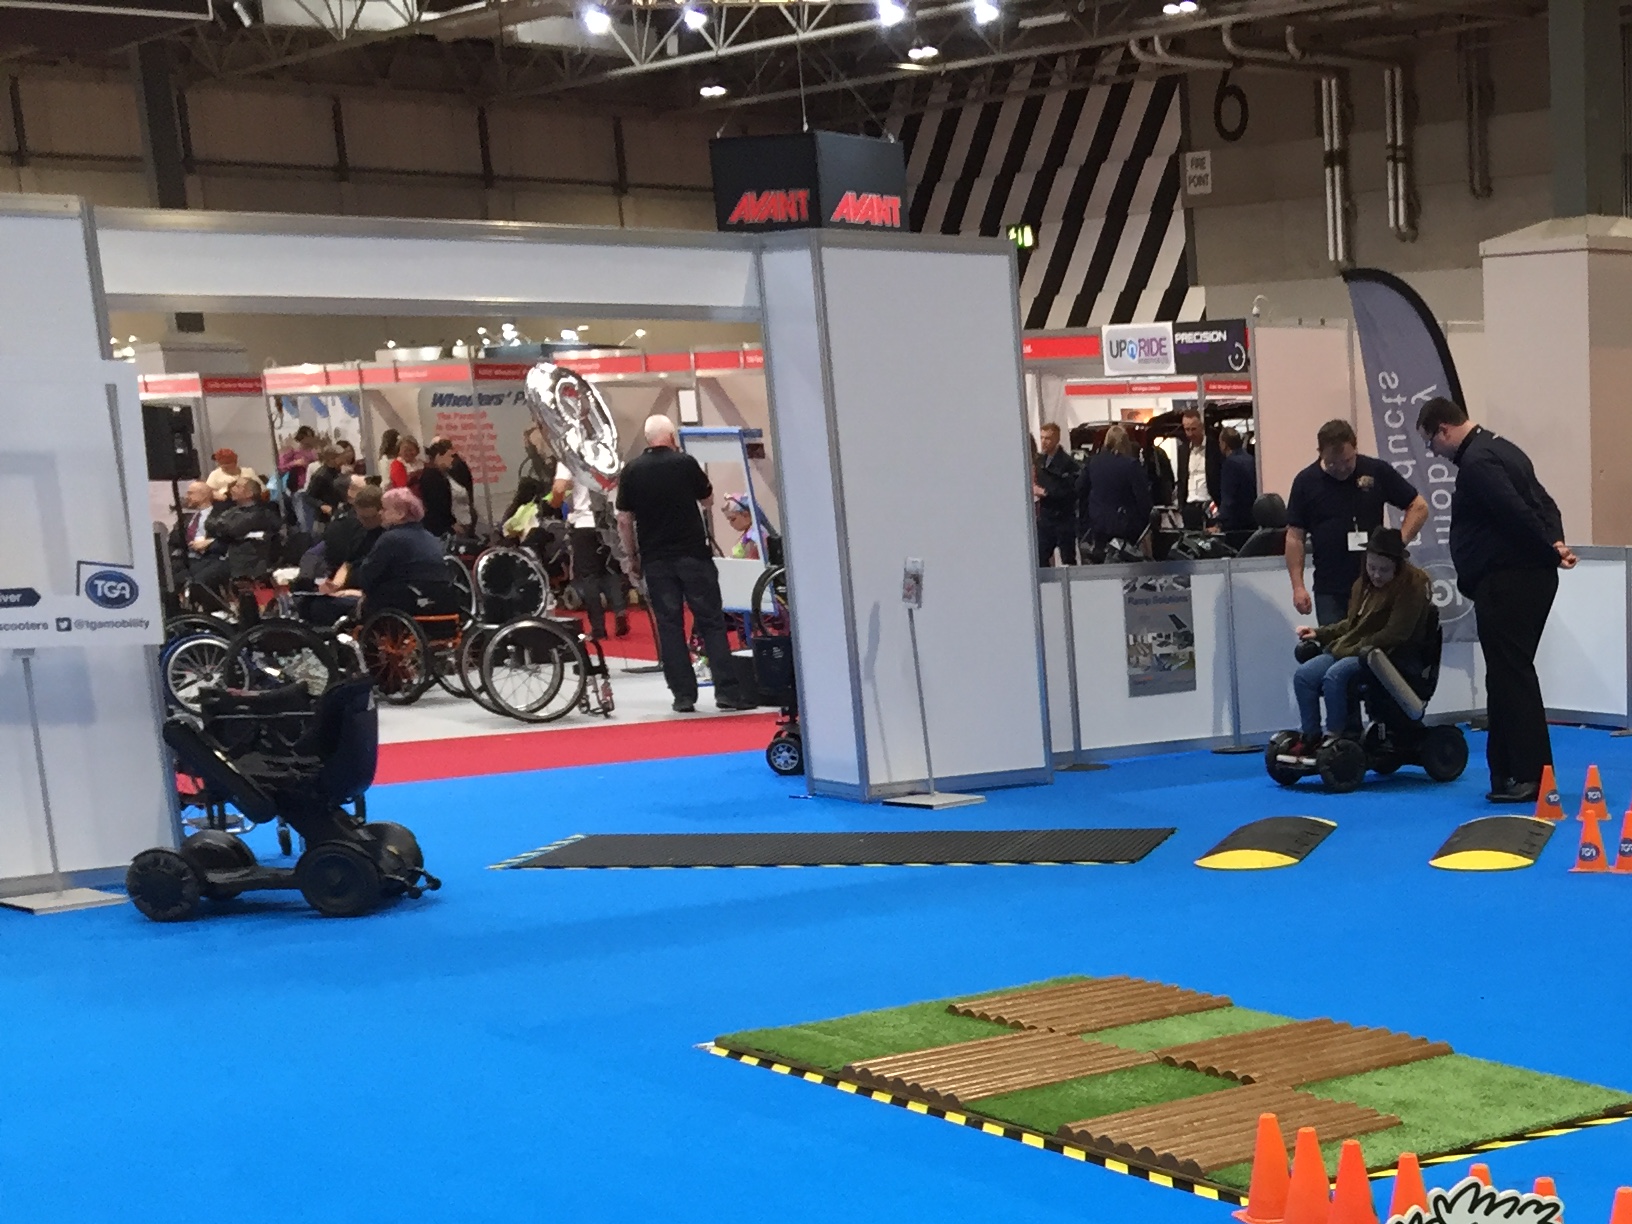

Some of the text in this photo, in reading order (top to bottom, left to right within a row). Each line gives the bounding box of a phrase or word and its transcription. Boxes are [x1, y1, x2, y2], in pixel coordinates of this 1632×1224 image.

[1214, 68, 1249, 142] 6
[726, 189, 809, 224] AVANT
[830, 190, 901, 228] AVANT
[1175, 330, 1228, 344] PRECISION
[93, 579, 131, 600] TGA
[1581, 847, 1596, 856] TGA
